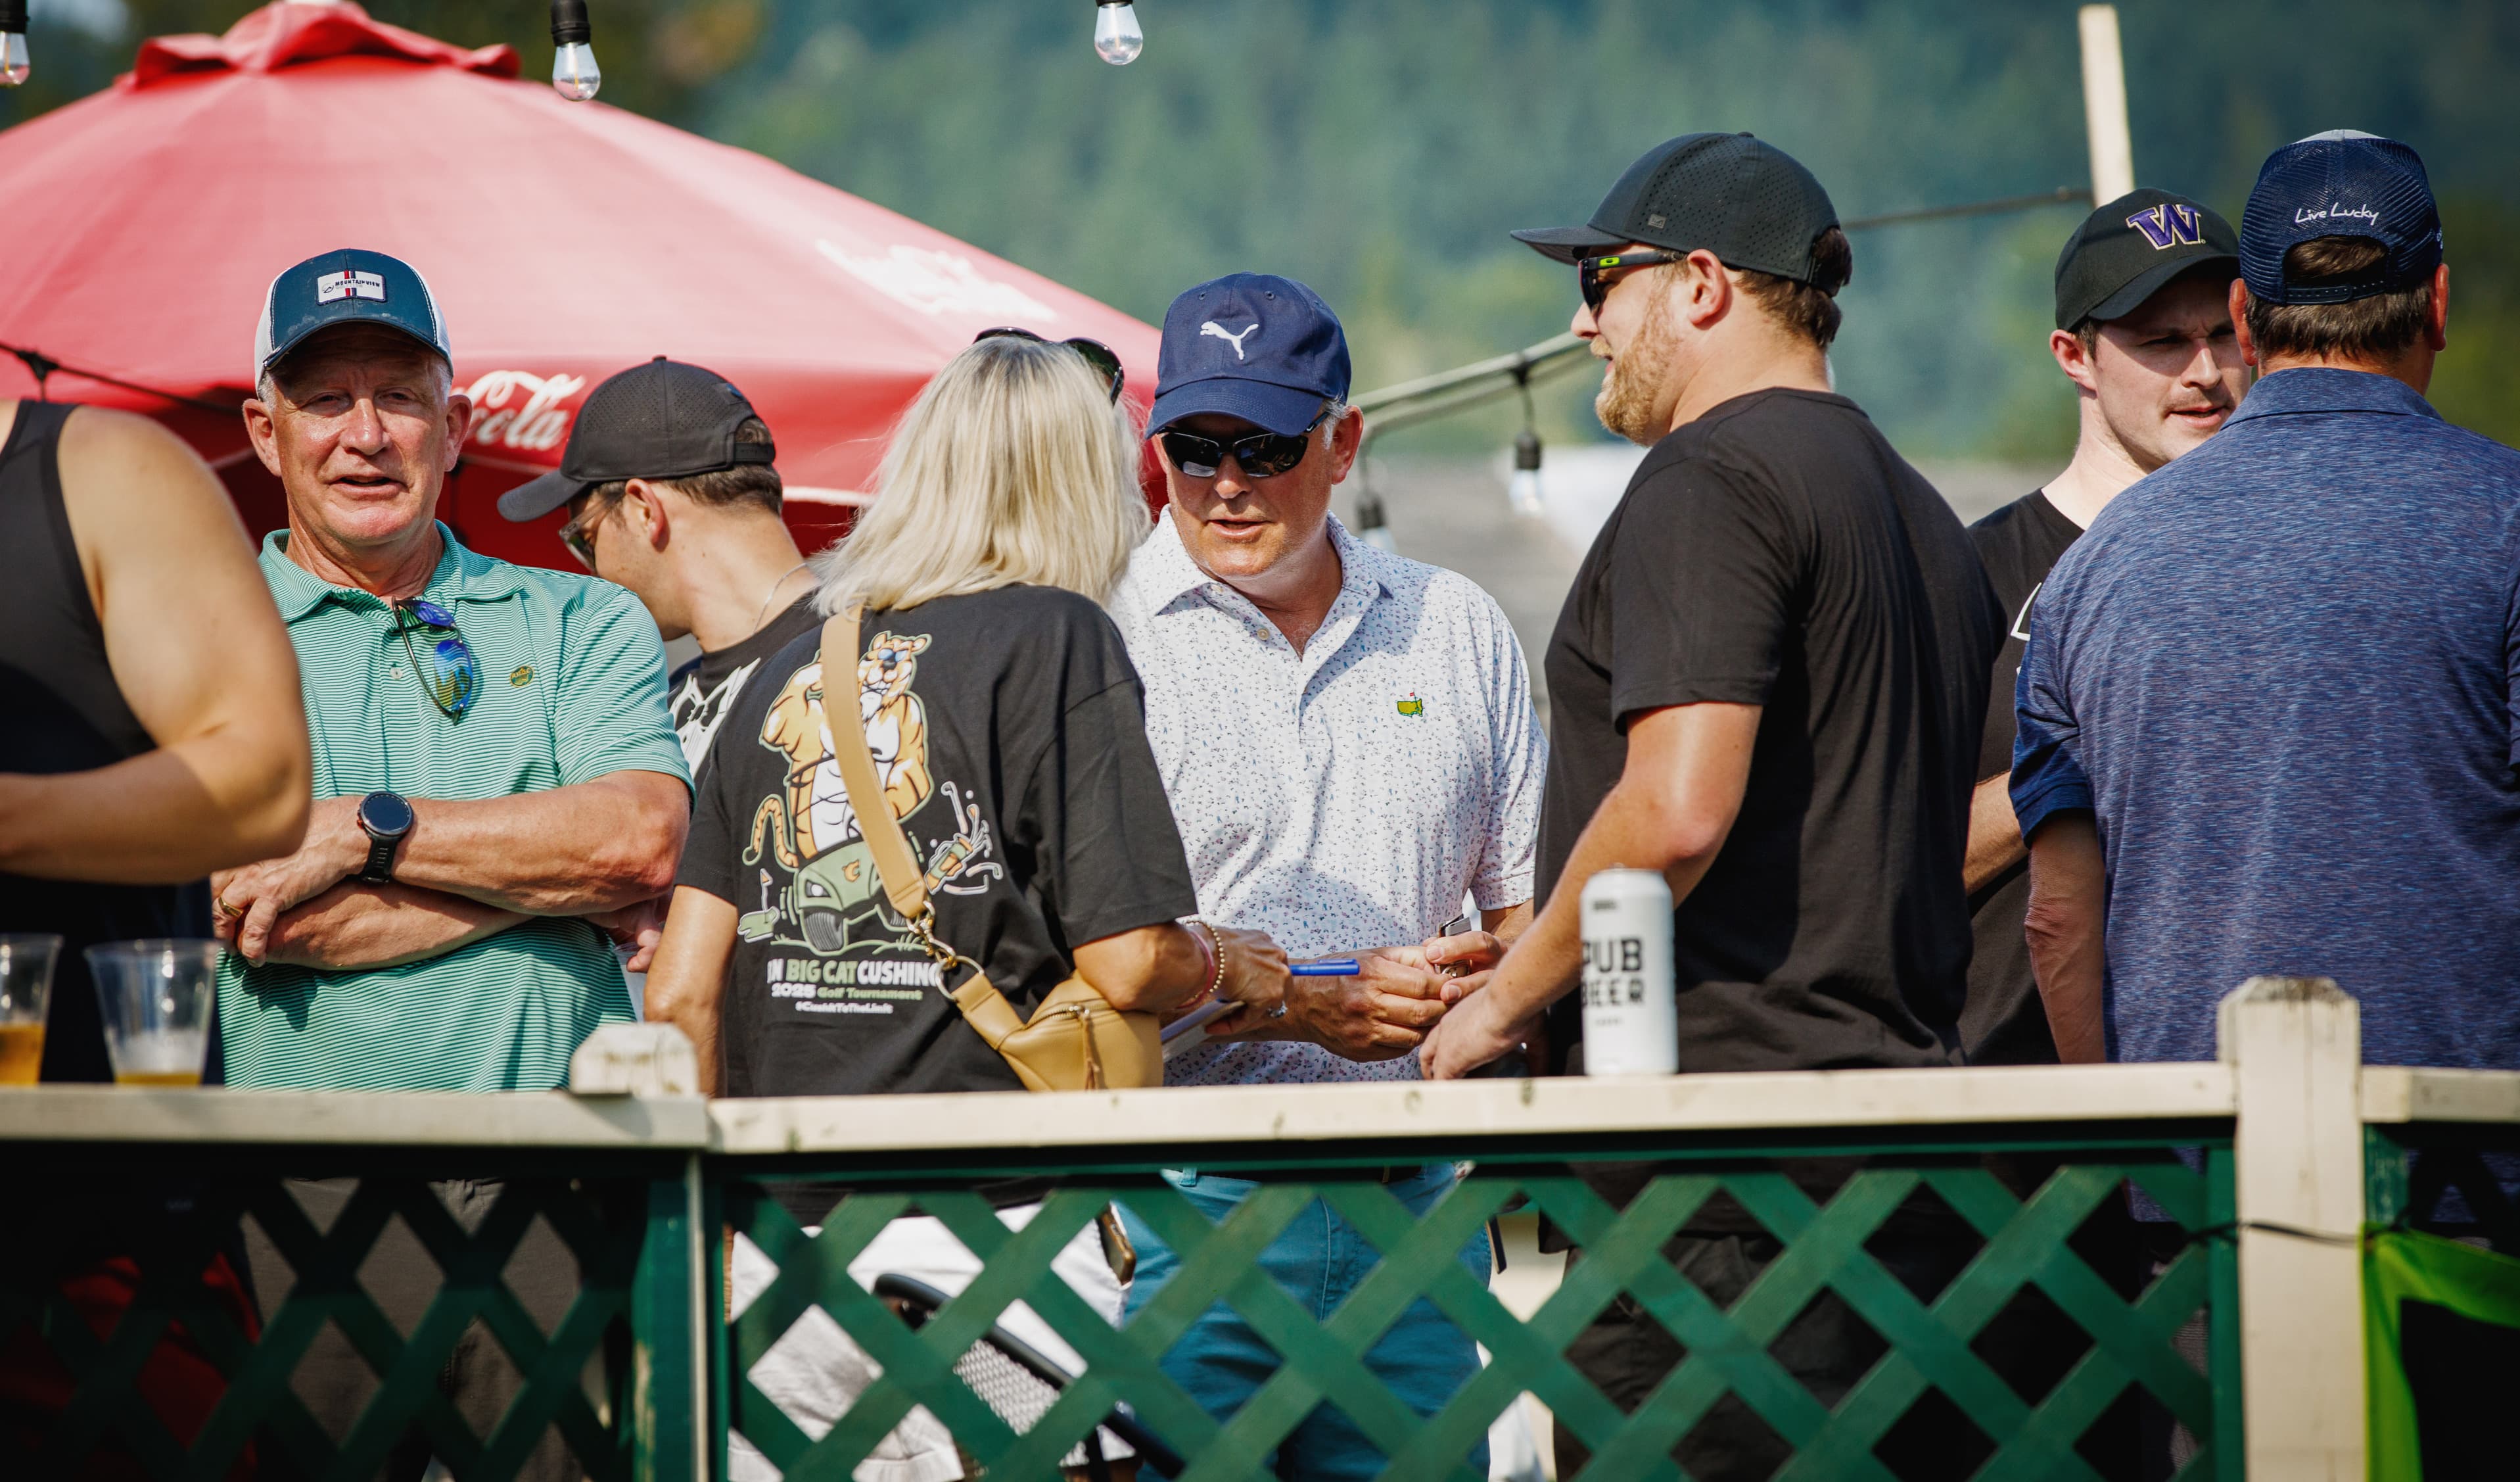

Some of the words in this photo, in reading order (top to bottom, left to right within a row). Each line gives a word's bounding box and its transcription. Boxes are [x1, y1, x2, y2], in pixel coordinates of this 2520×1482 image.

[2295, 208, 2327, 223] Live
[2331, 202, 2379, 226] Lucky
[2125, 203, 2202, 251] W
[785, 959, 821, 983] BIG
[822, 960, 858, 984] CAT
[772, 982, 816, 999] 2025
[817, 987, 845, 999] Golf
[846, 988, 923, 1001] Tournament
